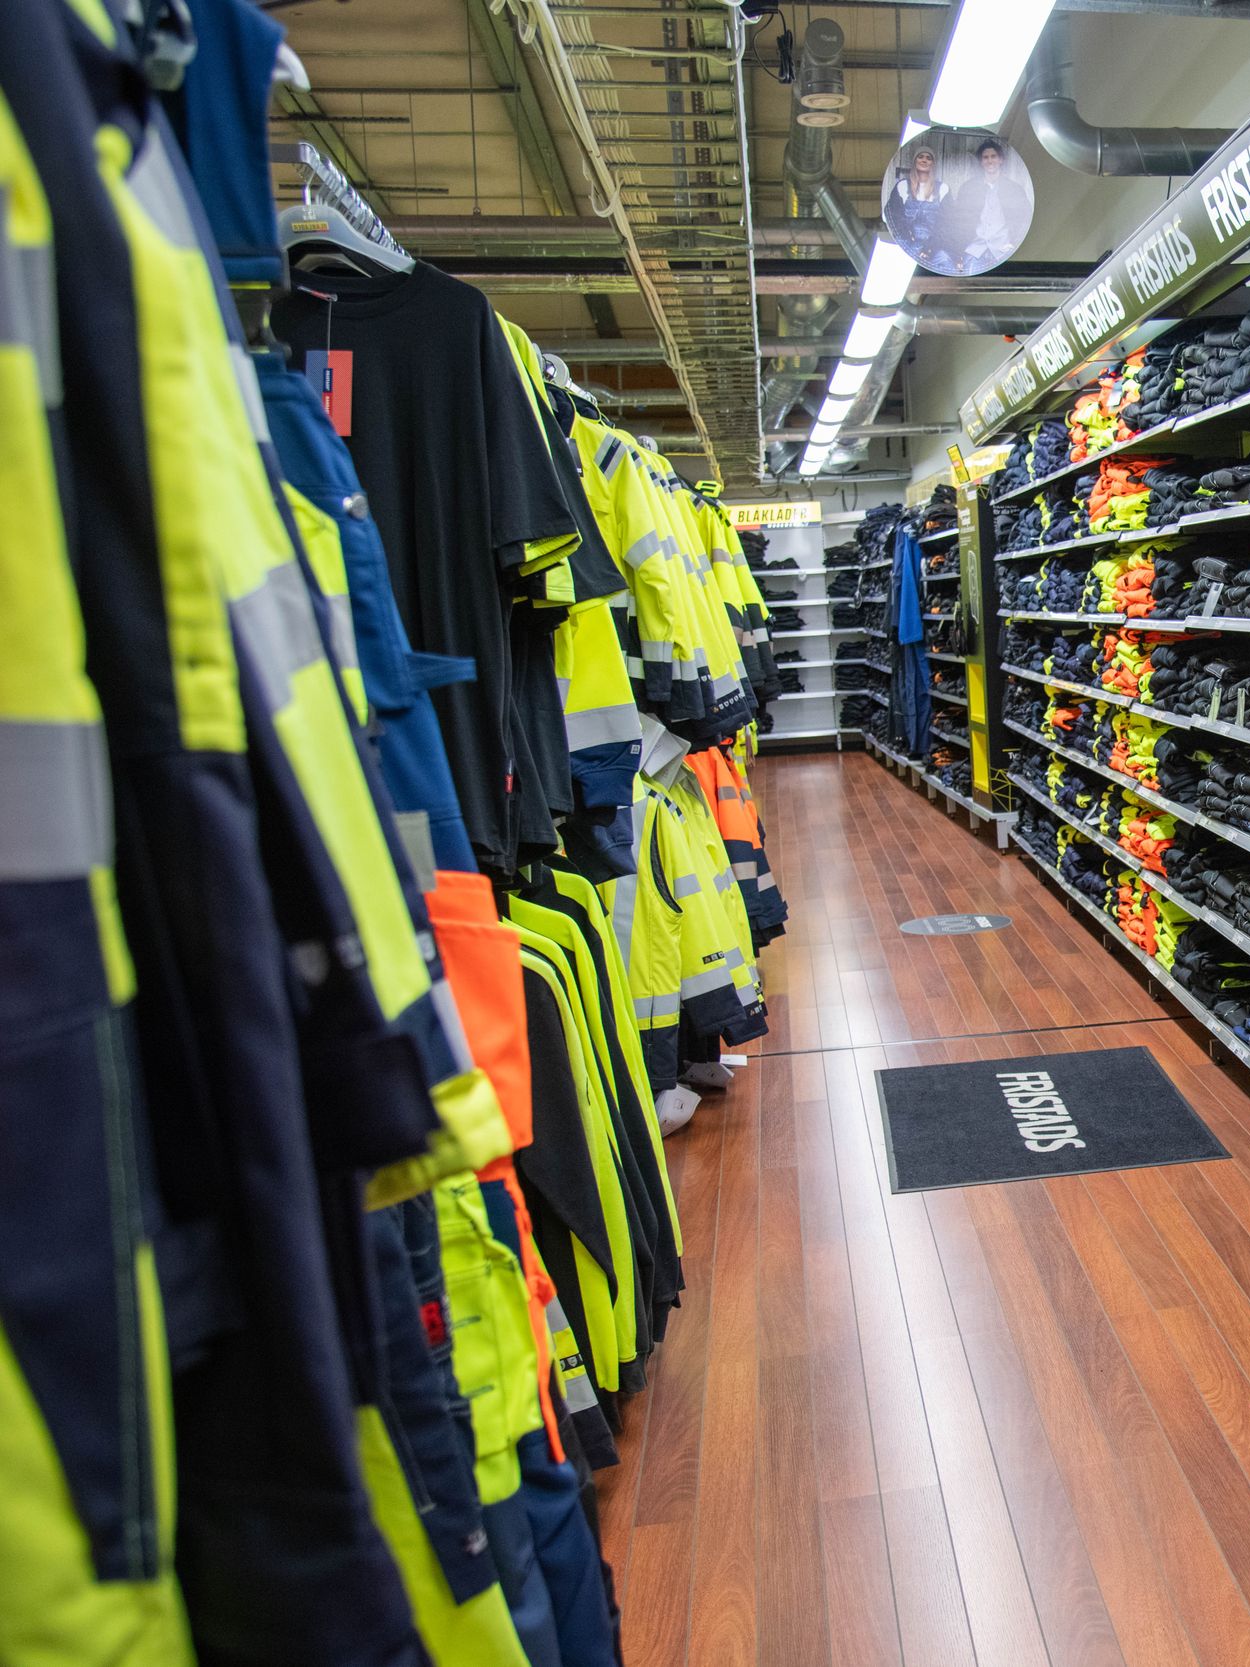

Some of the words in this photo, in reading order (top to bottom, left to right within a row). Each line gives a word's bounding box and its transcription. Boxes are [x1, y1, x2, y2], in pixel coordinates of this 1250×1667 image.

[1124, 212, 1197, 305] FRISTADS
[1069, 277, 1126, 349] FRISTADS
[1031, 323, 1074, 381] FRISTADS
[996, 1071, 1086, 1153] FRISTADS
